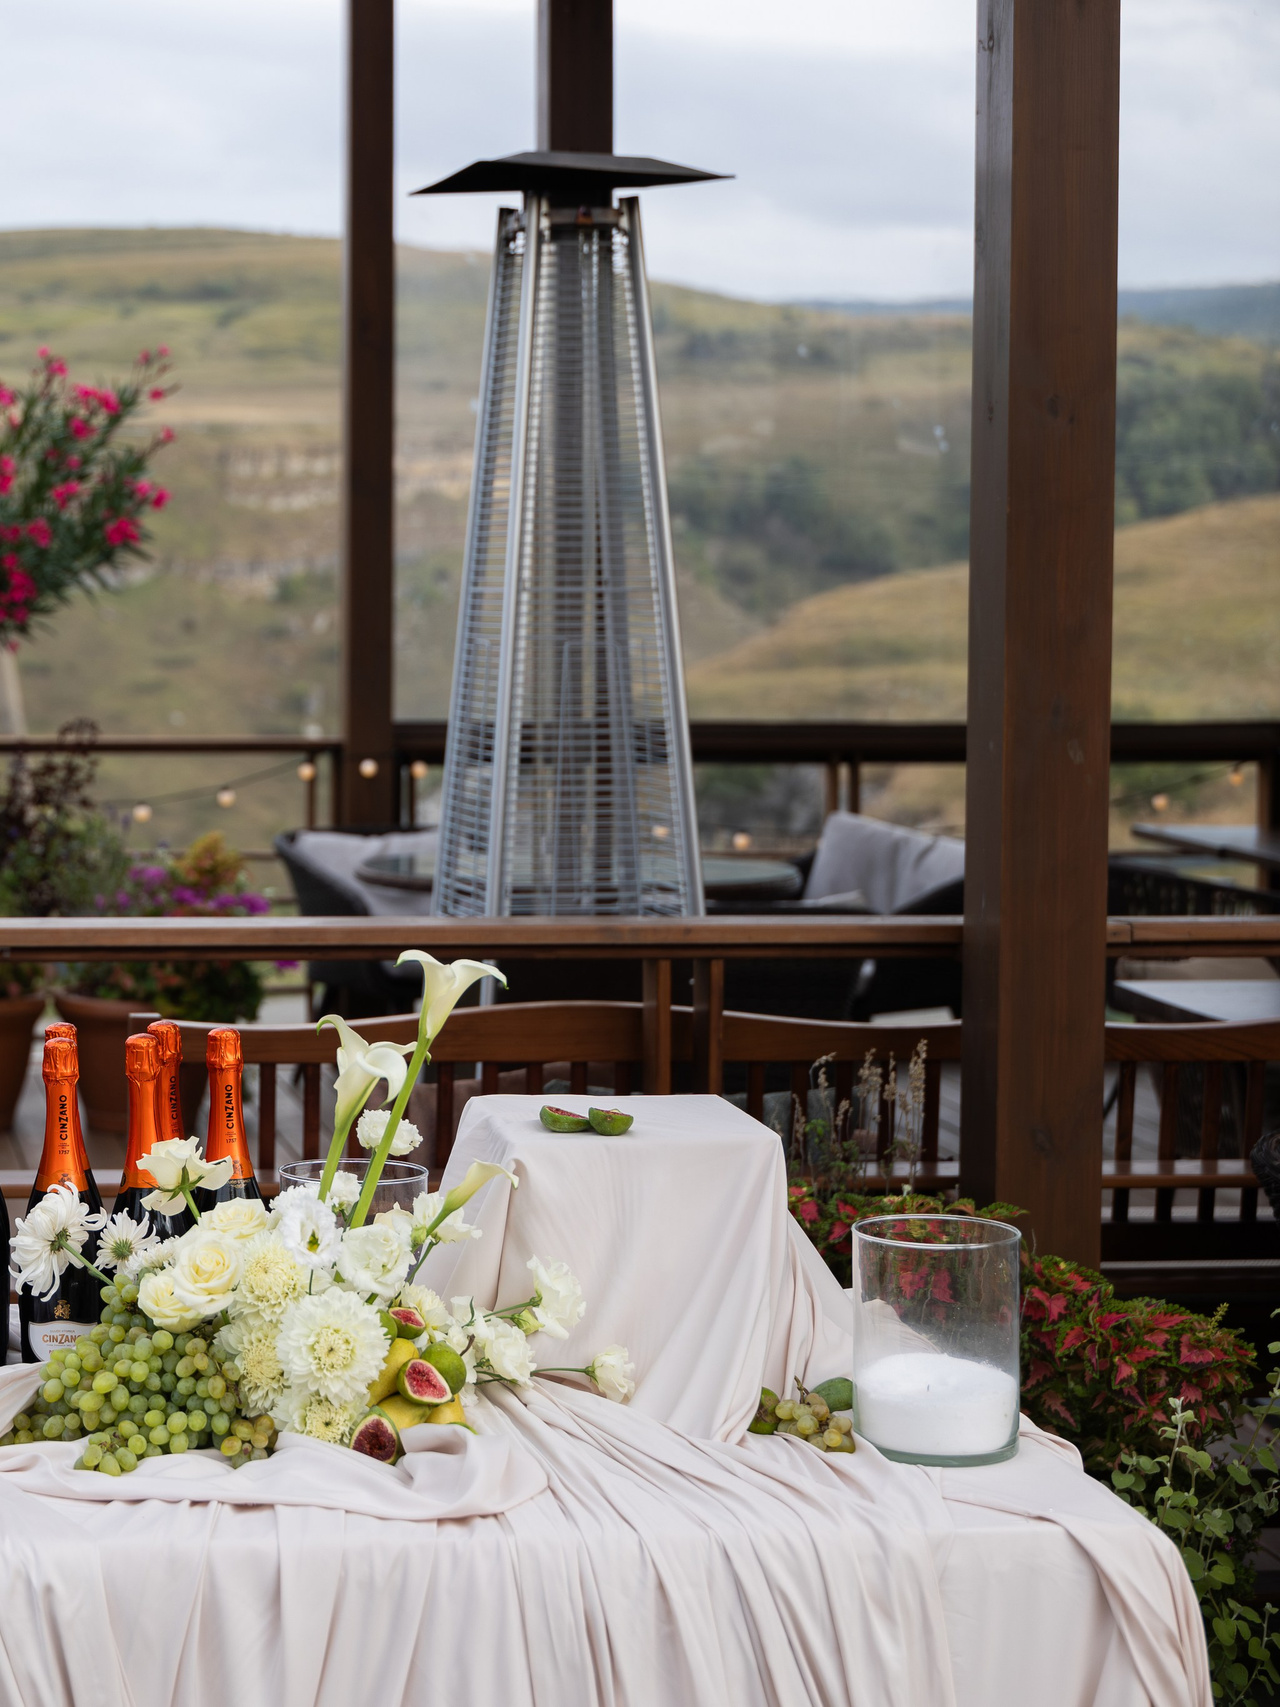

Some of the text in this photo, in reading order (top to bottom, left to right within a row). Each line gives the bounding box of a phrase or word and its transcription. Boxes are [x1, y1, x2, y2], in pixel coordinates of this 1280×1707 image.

[59, 1094, 69, 1141] CINZANO
[170, 1075, 178, 1120] CINZANO
[225, 1084, 235, 1130] CINZANO
